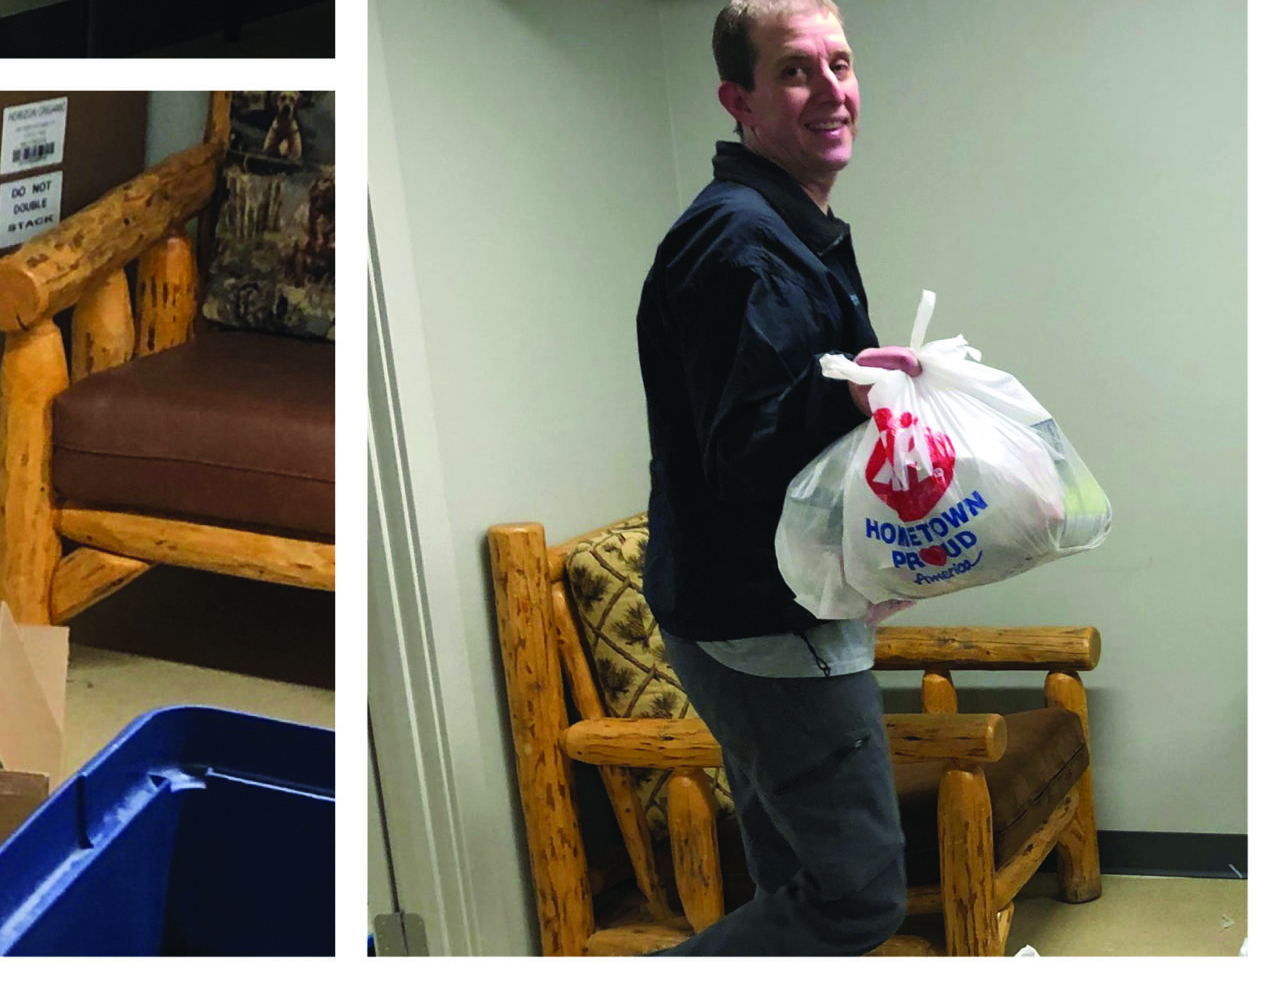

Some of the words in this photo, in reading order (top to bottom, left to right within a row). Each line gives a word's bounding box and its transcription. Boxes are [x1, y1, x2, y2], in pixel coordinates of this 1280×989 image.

[11, 187, 26, 198] DO
[32, 180, 52, 194] NOT
[13, 198, 47, 215] DOUBLE
[8, 214, 54, 232] STACK
[865, 490, 988, 547] HOMETOWN
